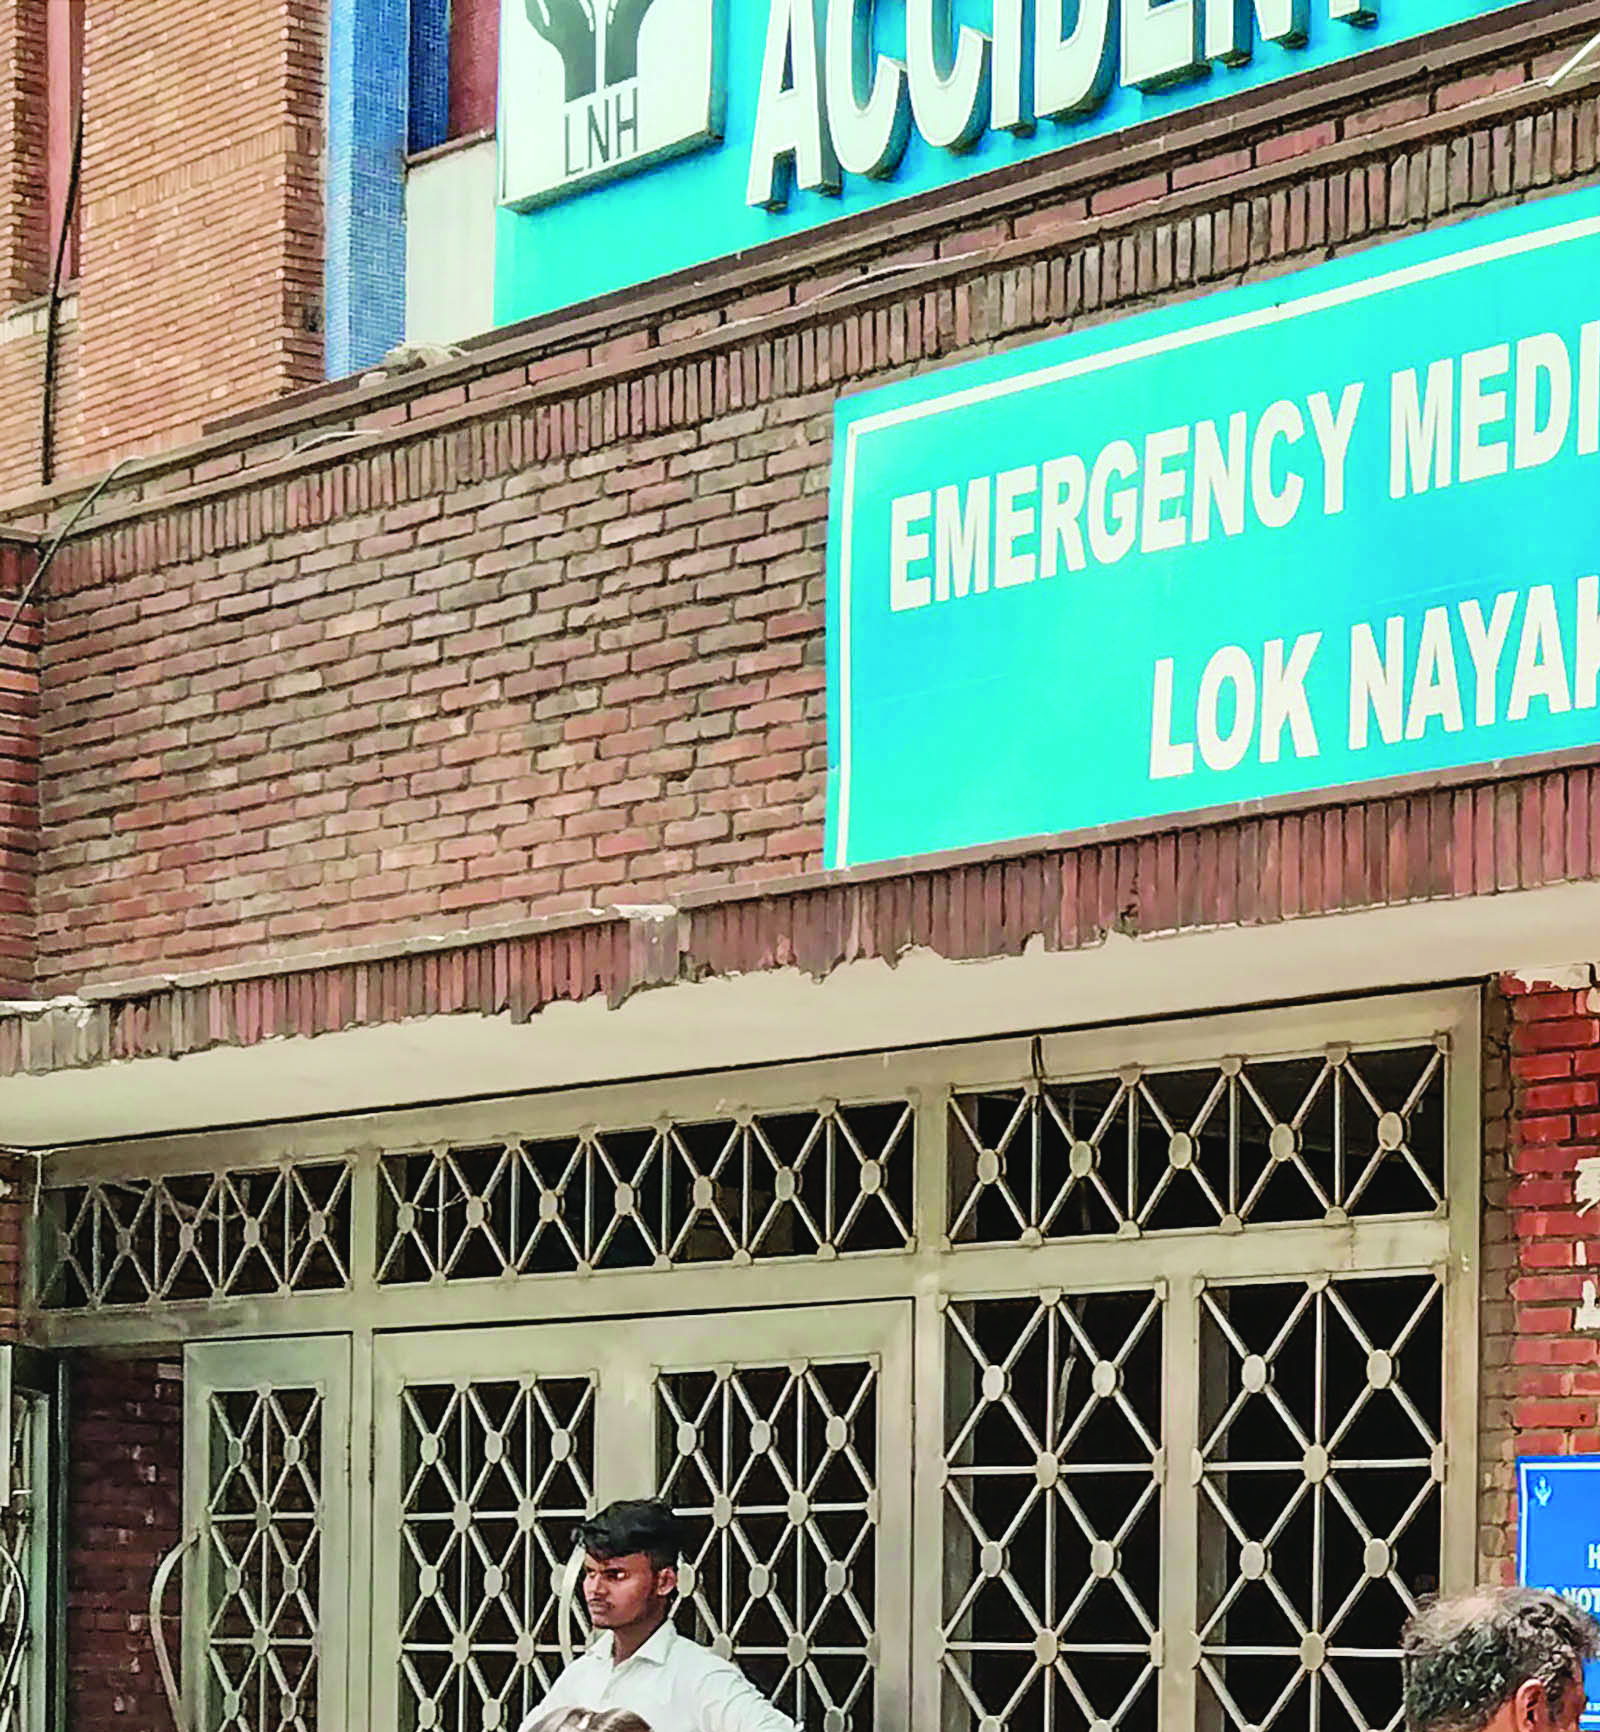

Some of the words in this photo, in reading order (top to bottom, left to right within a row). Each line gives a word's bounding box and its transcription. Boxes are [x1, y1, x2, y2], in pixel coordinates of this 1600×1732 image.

[563, 84, 639, 177] LNH
[746, 0, 1362, 206] ACCID
[889, 382, 1364, 612] EMERGENCY
[1149, 630, 1323, 780] LOK
